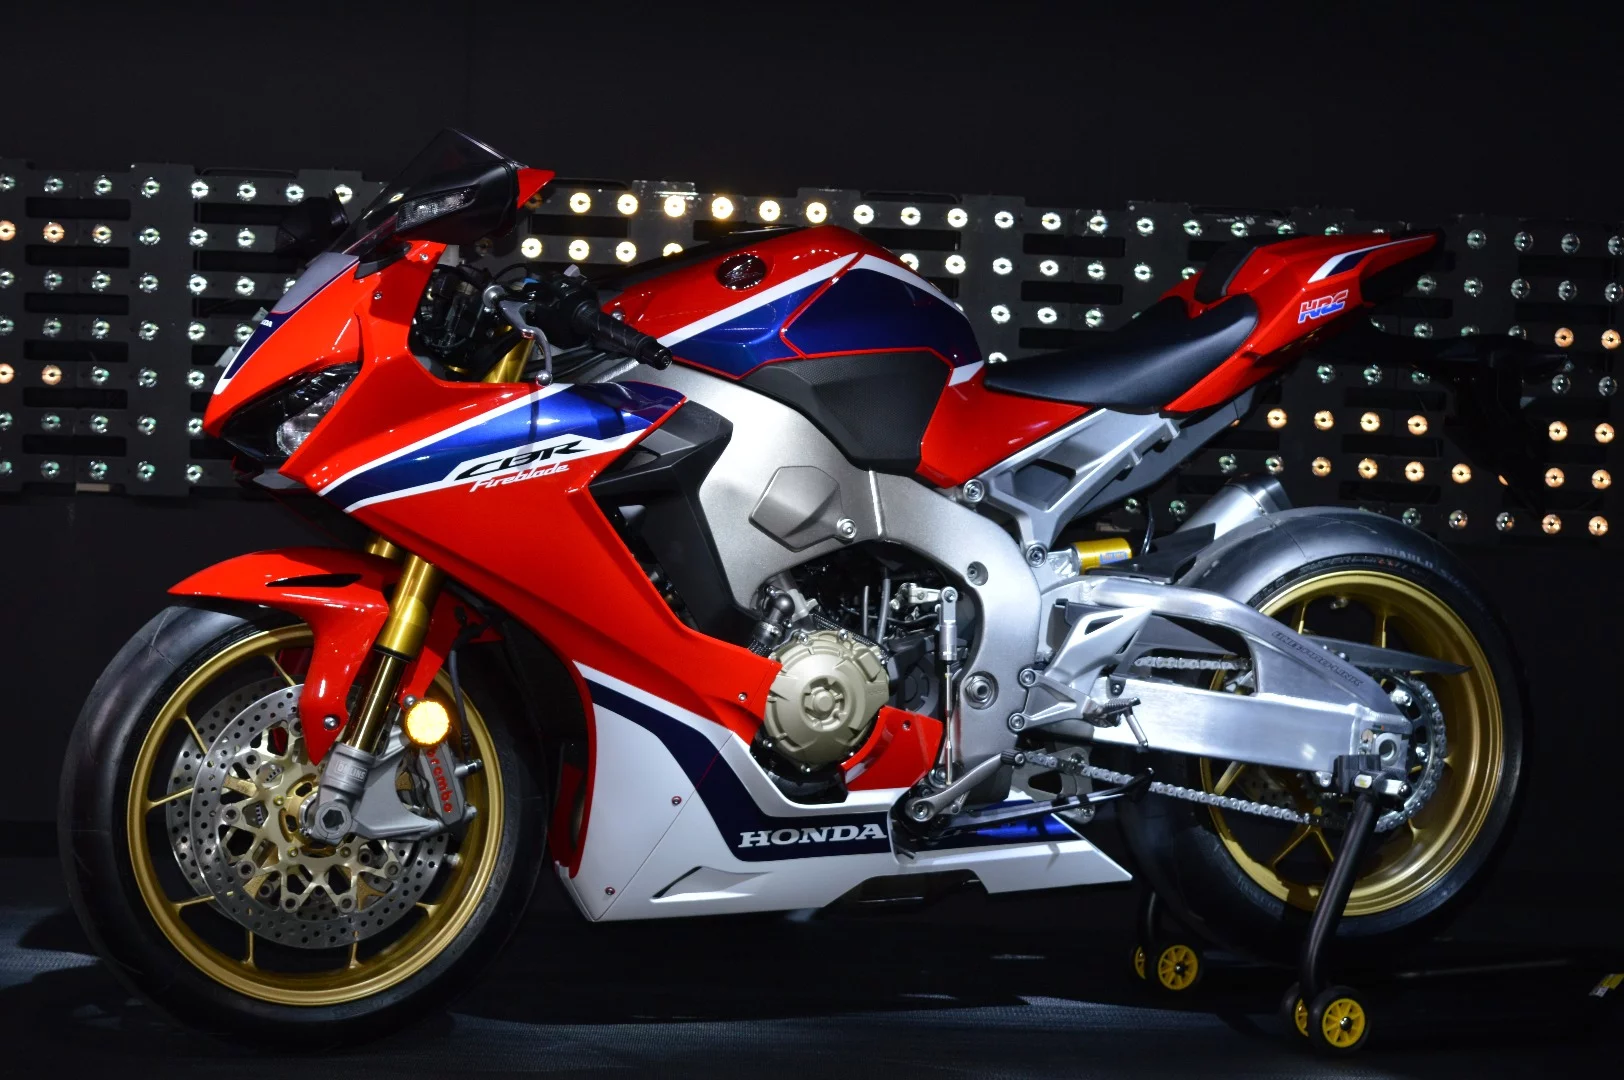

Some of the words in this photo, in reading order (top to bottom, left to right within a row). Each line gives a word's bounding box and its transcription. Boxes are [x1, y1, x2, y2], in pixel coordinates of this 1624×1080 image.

[1298, 289, 1348, 324] HRC
[454, 440, 590, 481] CBR
[469, 463, 569, 492] Fireblade
[738, 823, 887, 848] HONDA
